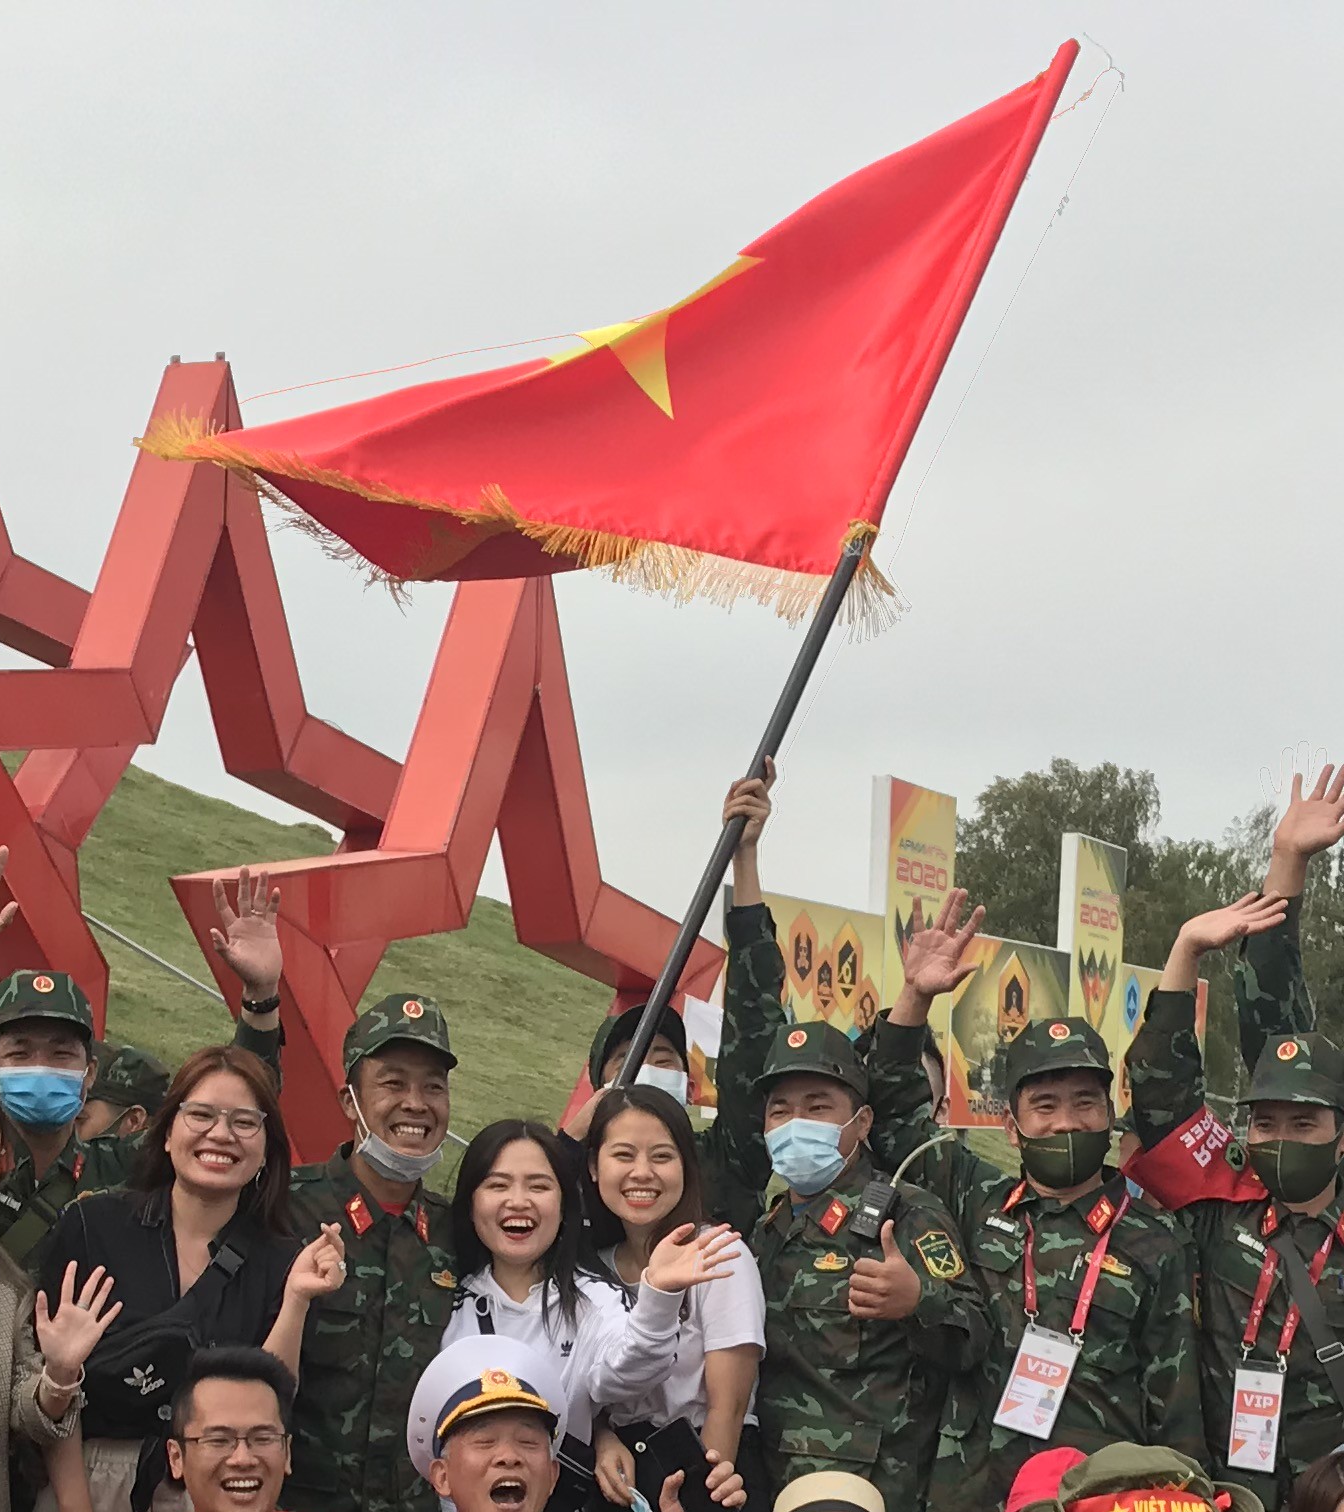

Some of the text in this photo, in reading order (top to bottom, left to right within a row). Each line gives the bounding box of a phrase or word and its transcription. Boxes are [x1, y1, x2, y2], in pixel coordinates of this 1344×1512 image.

[896, 856, 947, 892] 2020
[1080, 903, 1119, 931] 2020
[1027, 1357, 1063, 1378] VIP
[1243, 1393, 1274, 1409] VIP
